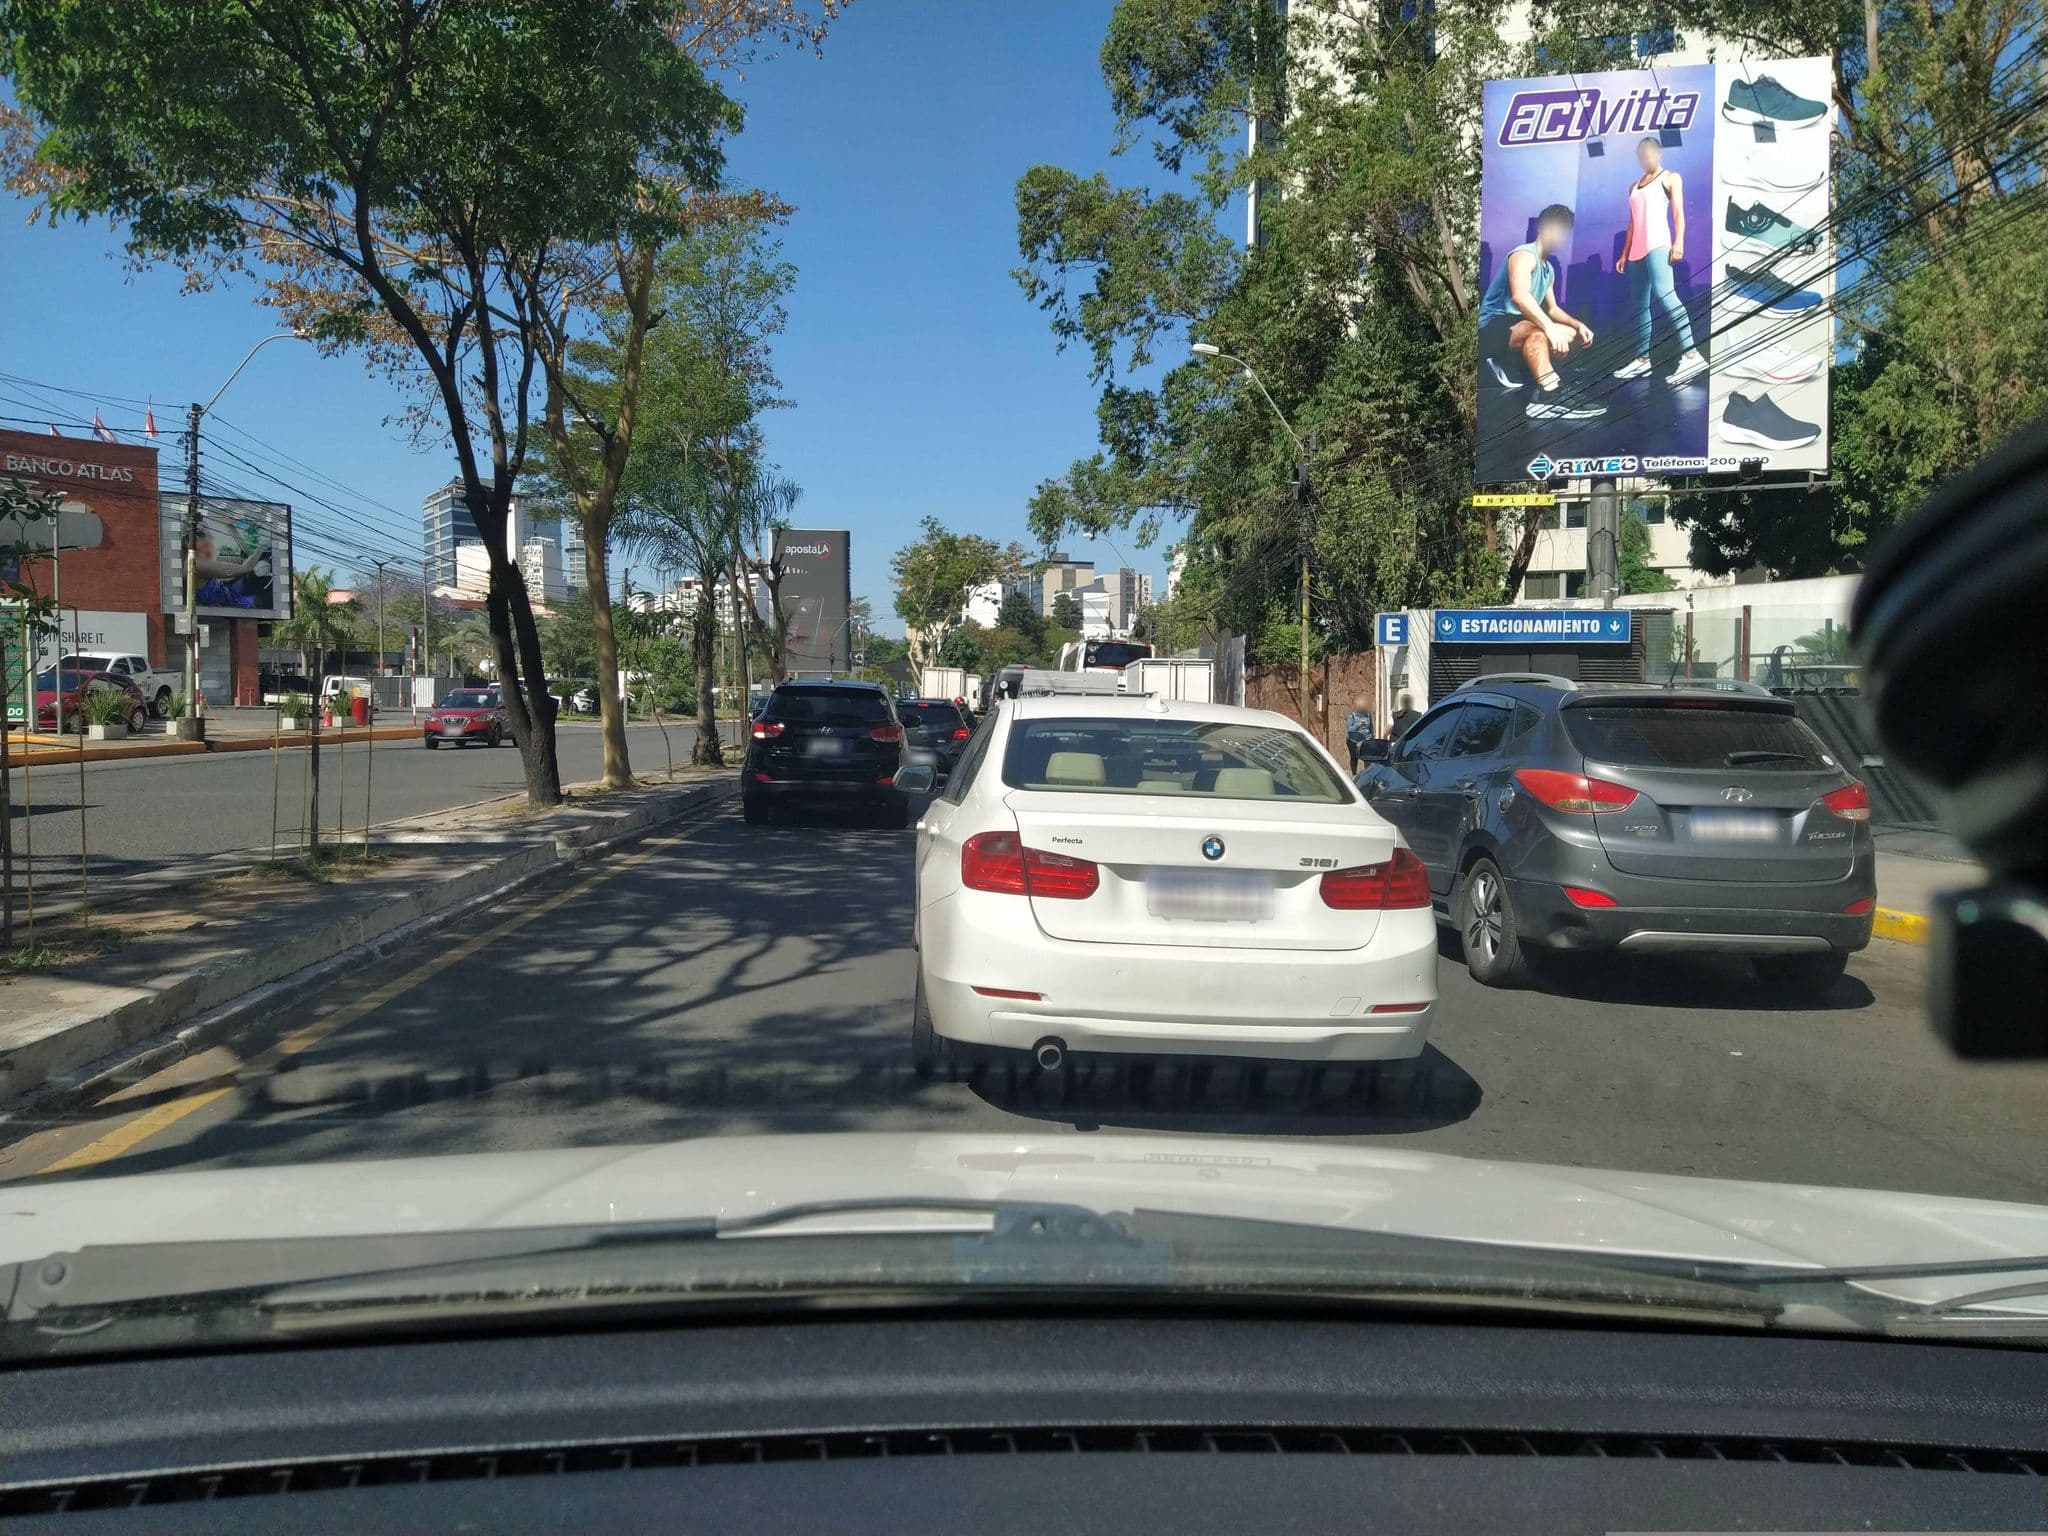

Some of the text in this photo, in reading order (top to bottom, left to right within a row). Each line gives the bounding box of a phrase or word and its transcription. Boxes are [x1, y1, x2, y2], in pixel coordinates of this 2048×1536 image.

[6, 455, 133, 482] BANCO ATLAS
[1644, 458, 1705, 467] Teléfono:
[1386, 618, 1401, 641] E
[1461, 618, 1600, 634] ESTACIONAMIENTO
[1052, 836, 1083, 844] Perfecta
